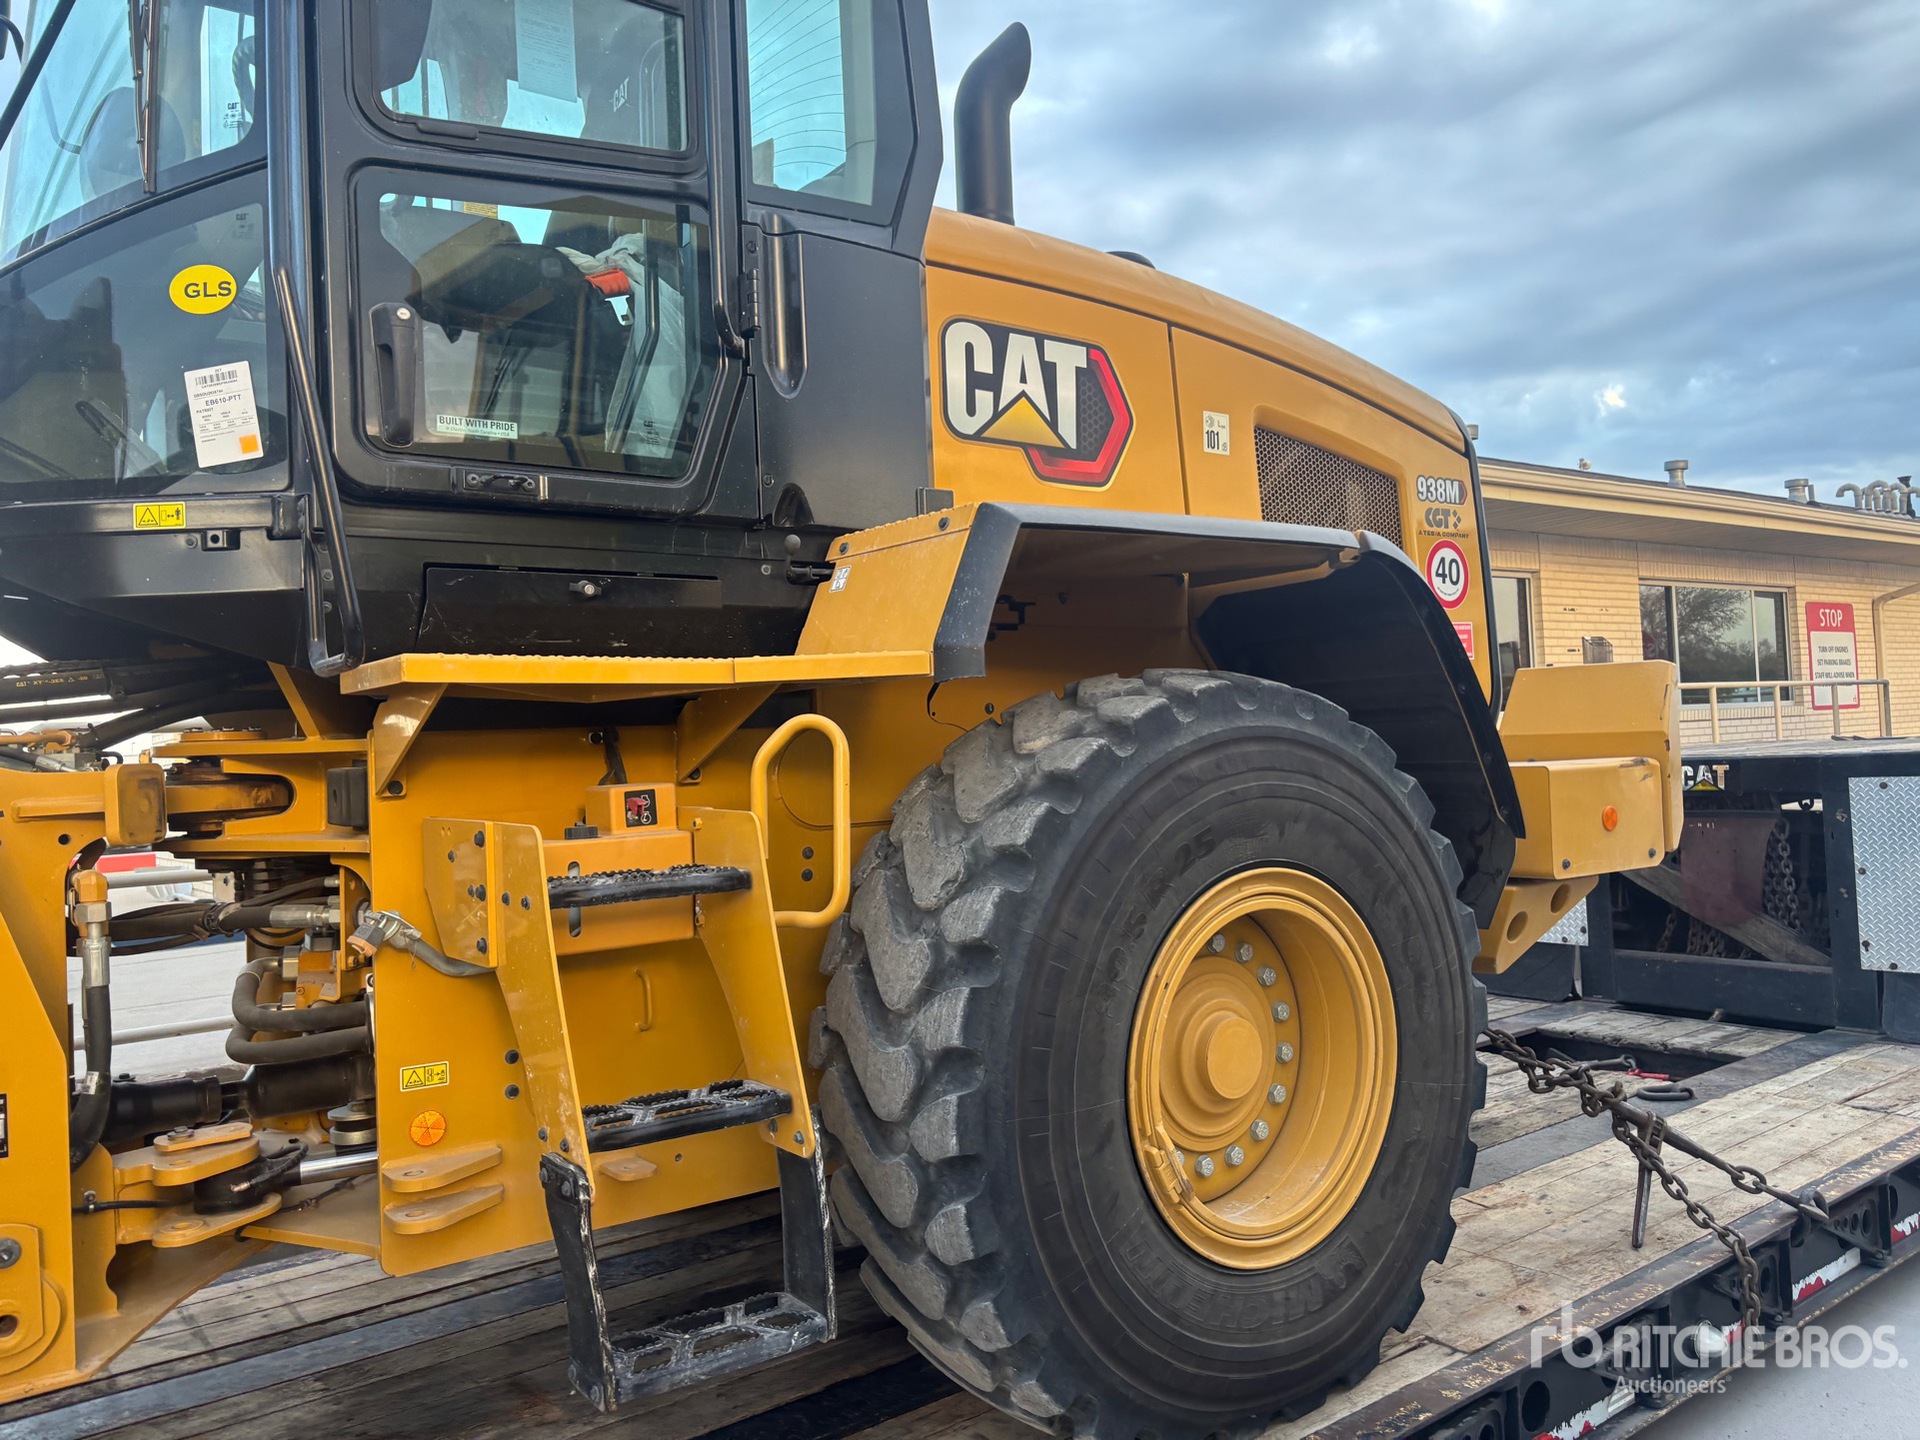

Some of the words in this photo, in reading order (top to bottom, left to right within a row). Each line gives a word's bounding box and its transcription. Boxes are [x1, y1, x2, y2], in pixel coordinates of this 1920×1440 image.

[184, 281, 233, 299] GLS
[944, 321, 1088, 450] CAT
[439, 416, 463, 426] BUILT
[465, 419, 488, 429] WITH
[490, 421, 515, 431] PRIDE
[1205, 430, 1220, 450] 101
[1416, 475, 1460, 504] 938M
[1424, 507, 1451, 529] CGT
[1442, 531, 1469, 539] COMPANY
[1435, 557, 1460, 586] 40
[1819, 608, 1843, 627] STOP
[1815, 671, 1825, 679] STAFF
[1682, 764, 1730, 791] CAT
